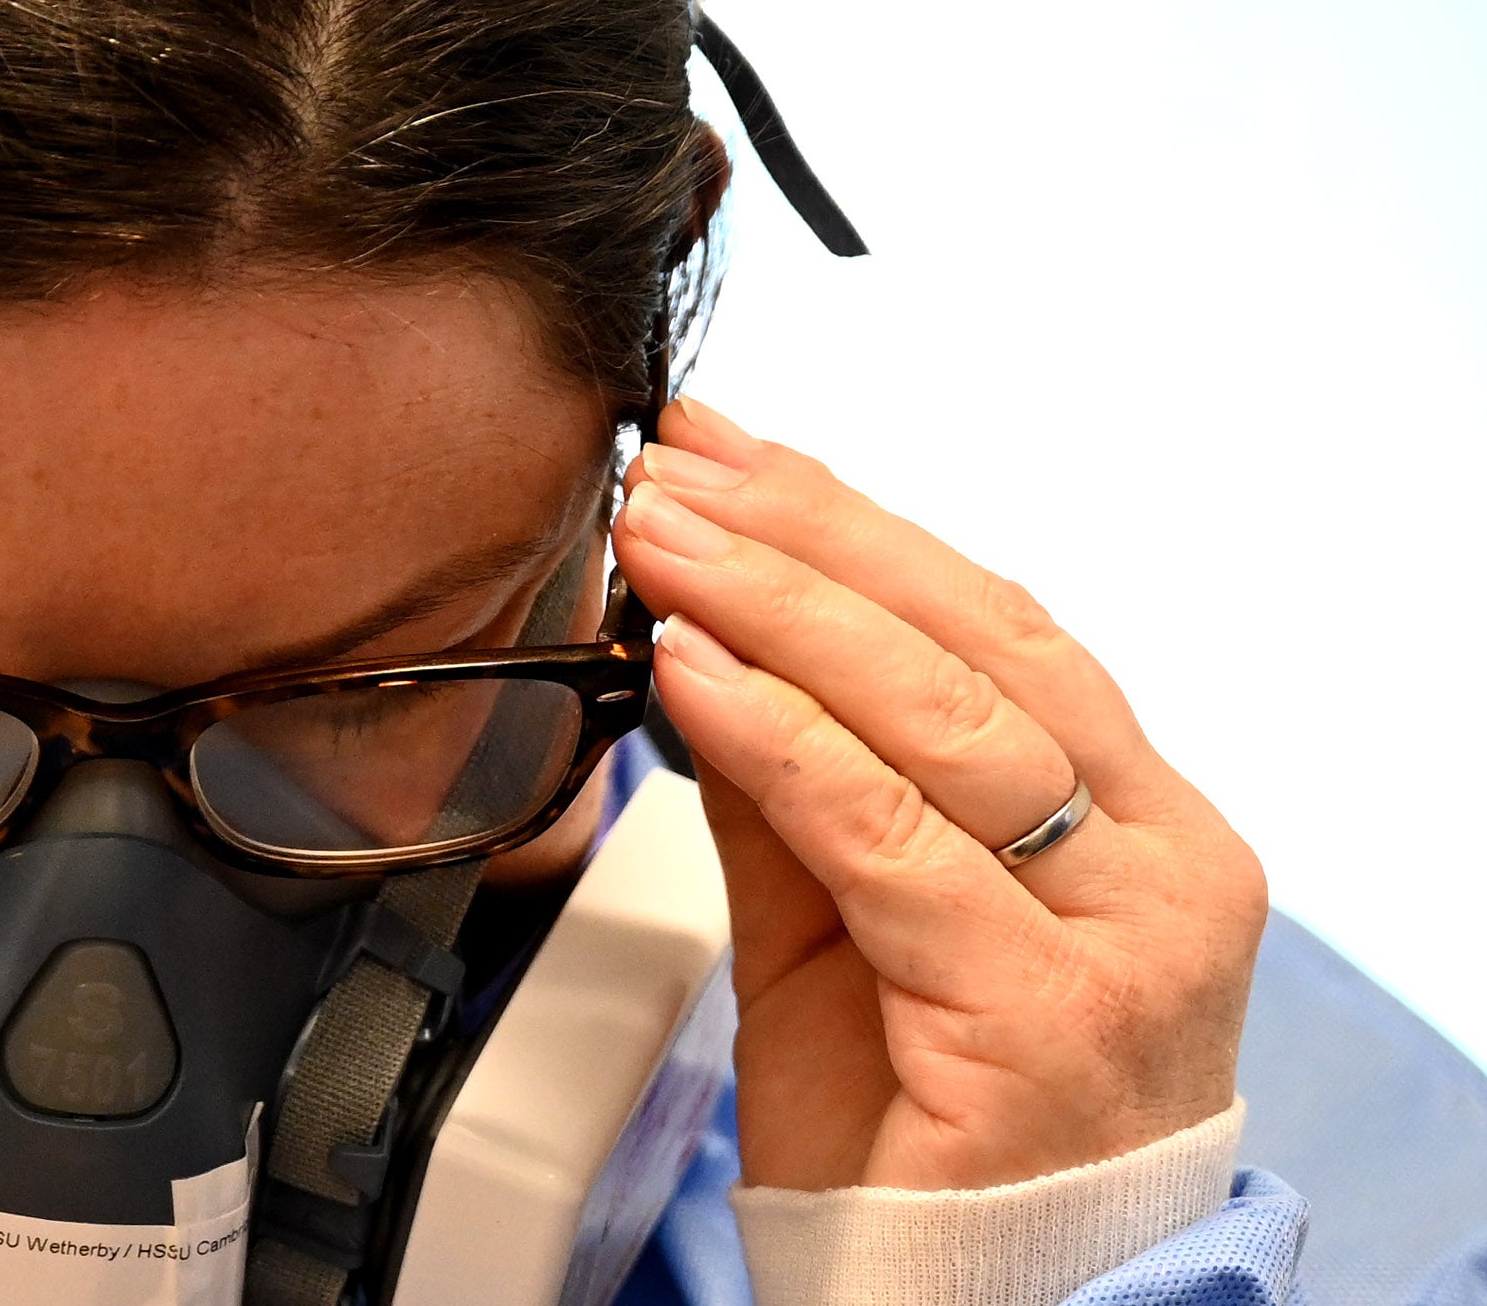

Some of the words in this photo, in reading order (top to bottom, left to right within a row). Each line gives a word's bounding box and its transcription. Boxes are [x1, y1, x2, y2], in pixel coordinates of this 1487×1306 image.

[27, 1236, 121, 1262] Wetherby
[122, 1244, 132, 1259] /
[137, 1243, 190, 1261] HSSU
